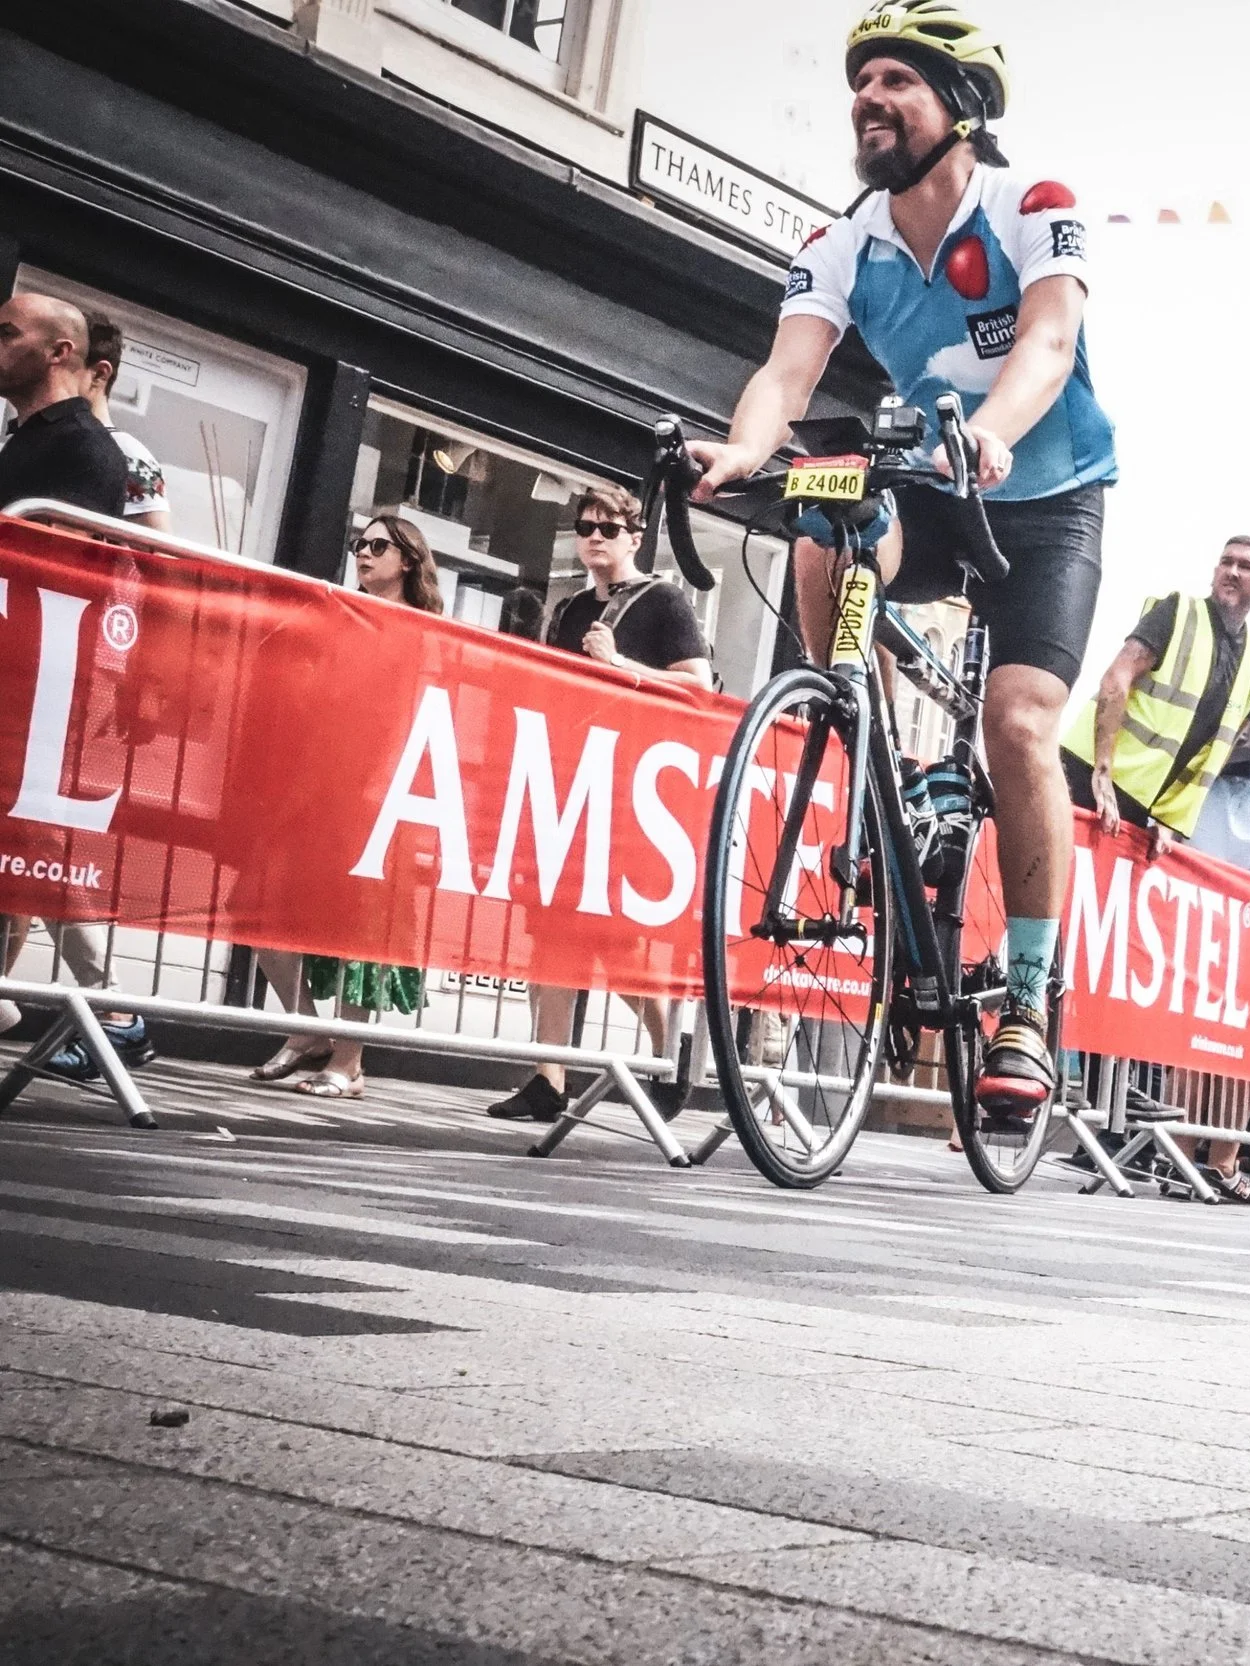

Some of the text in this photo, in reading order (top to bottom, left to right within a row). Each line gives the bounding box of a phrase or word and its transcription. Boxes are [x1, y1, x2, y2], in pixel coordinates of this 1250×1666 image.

[652, 142, 752, 216] THAMES
[977, 313, 1015, 333] British
[790, 474, 858, 494] B 24040
[348, 685, 874, 957] AMSTE
[763, 964, 872, 996] drinkaware.co.u
